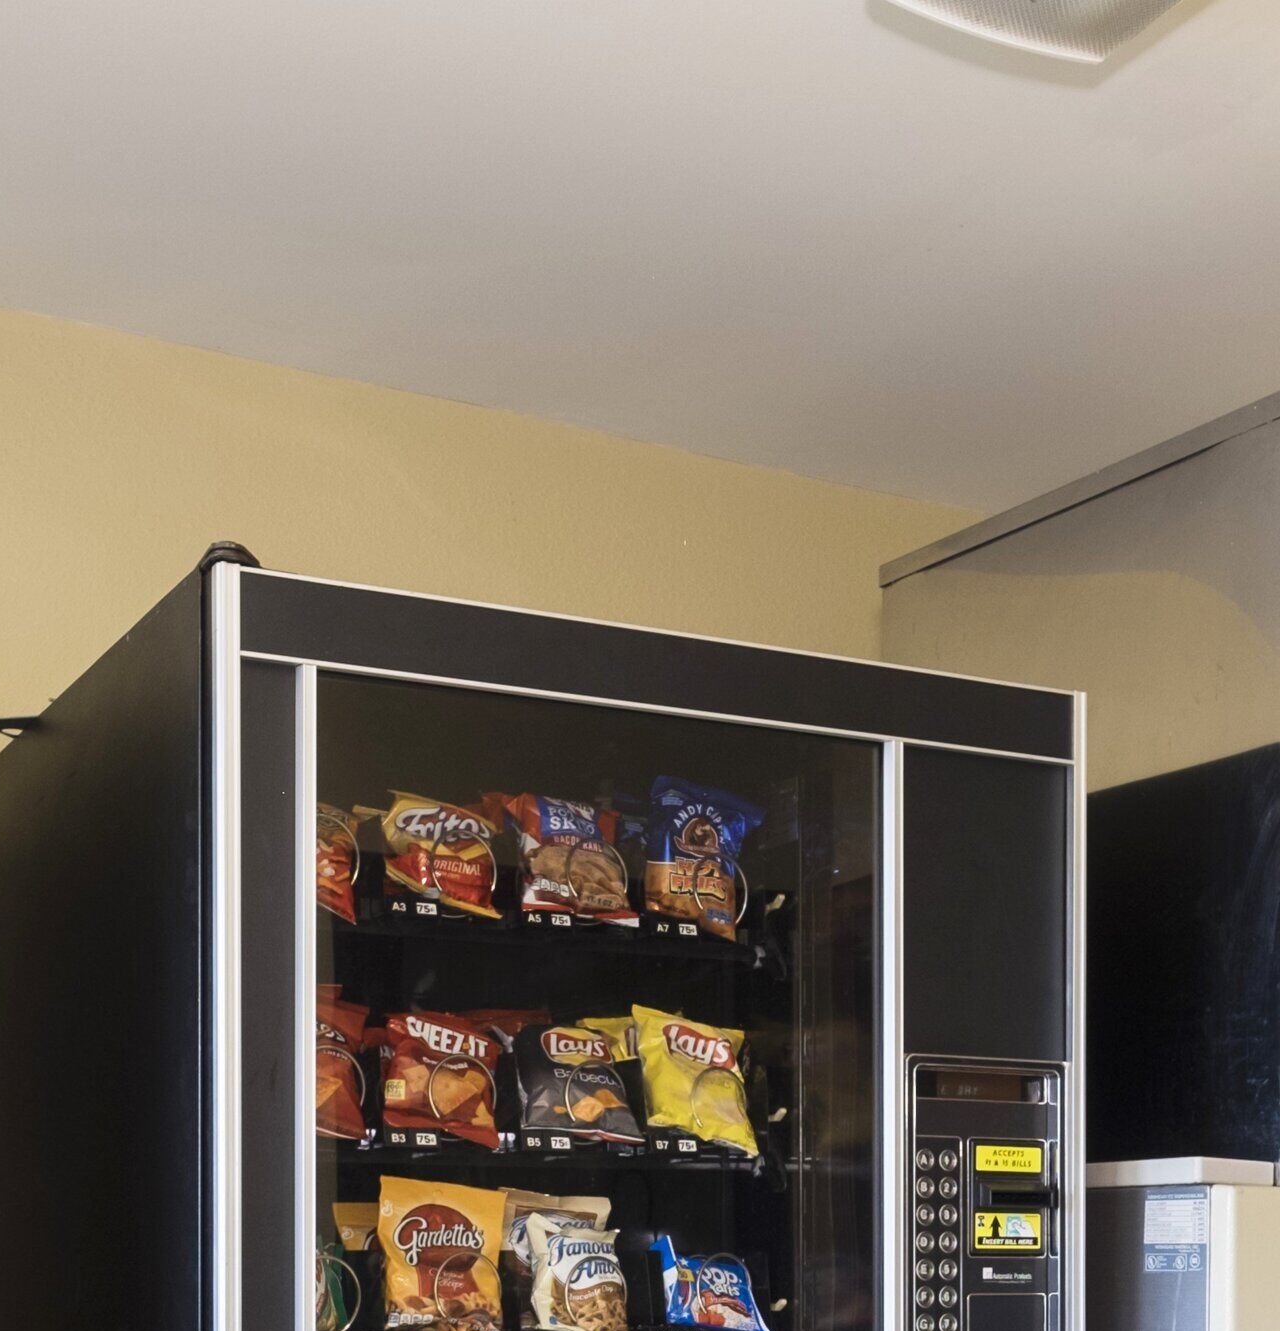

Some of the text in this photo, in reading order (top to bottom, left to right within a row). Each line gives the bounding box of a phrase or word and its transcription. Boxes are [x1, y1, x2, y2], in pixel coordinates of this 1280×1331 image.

[673, 803, 702, 828] ANDY
[395, 807, 491, 842] Fritos
[434, 860, 481, 876] ORIGINAL
[392, 901, 406, 912] A3
[528, 913, 542, 923] A5
[657, 923, 669, 933] A7
[392, 1133, 406, 1143] B3
[527, 1137, 541, 1146] B5
[656, 1140, 668, 1149] B7
[920, 1154, 928, 1165] A
[1012, 1160, 1032, 1168] BILLS
[394, 1216, 484, 1266] Gardetto's
[920, 1319, 928, 1329] G
